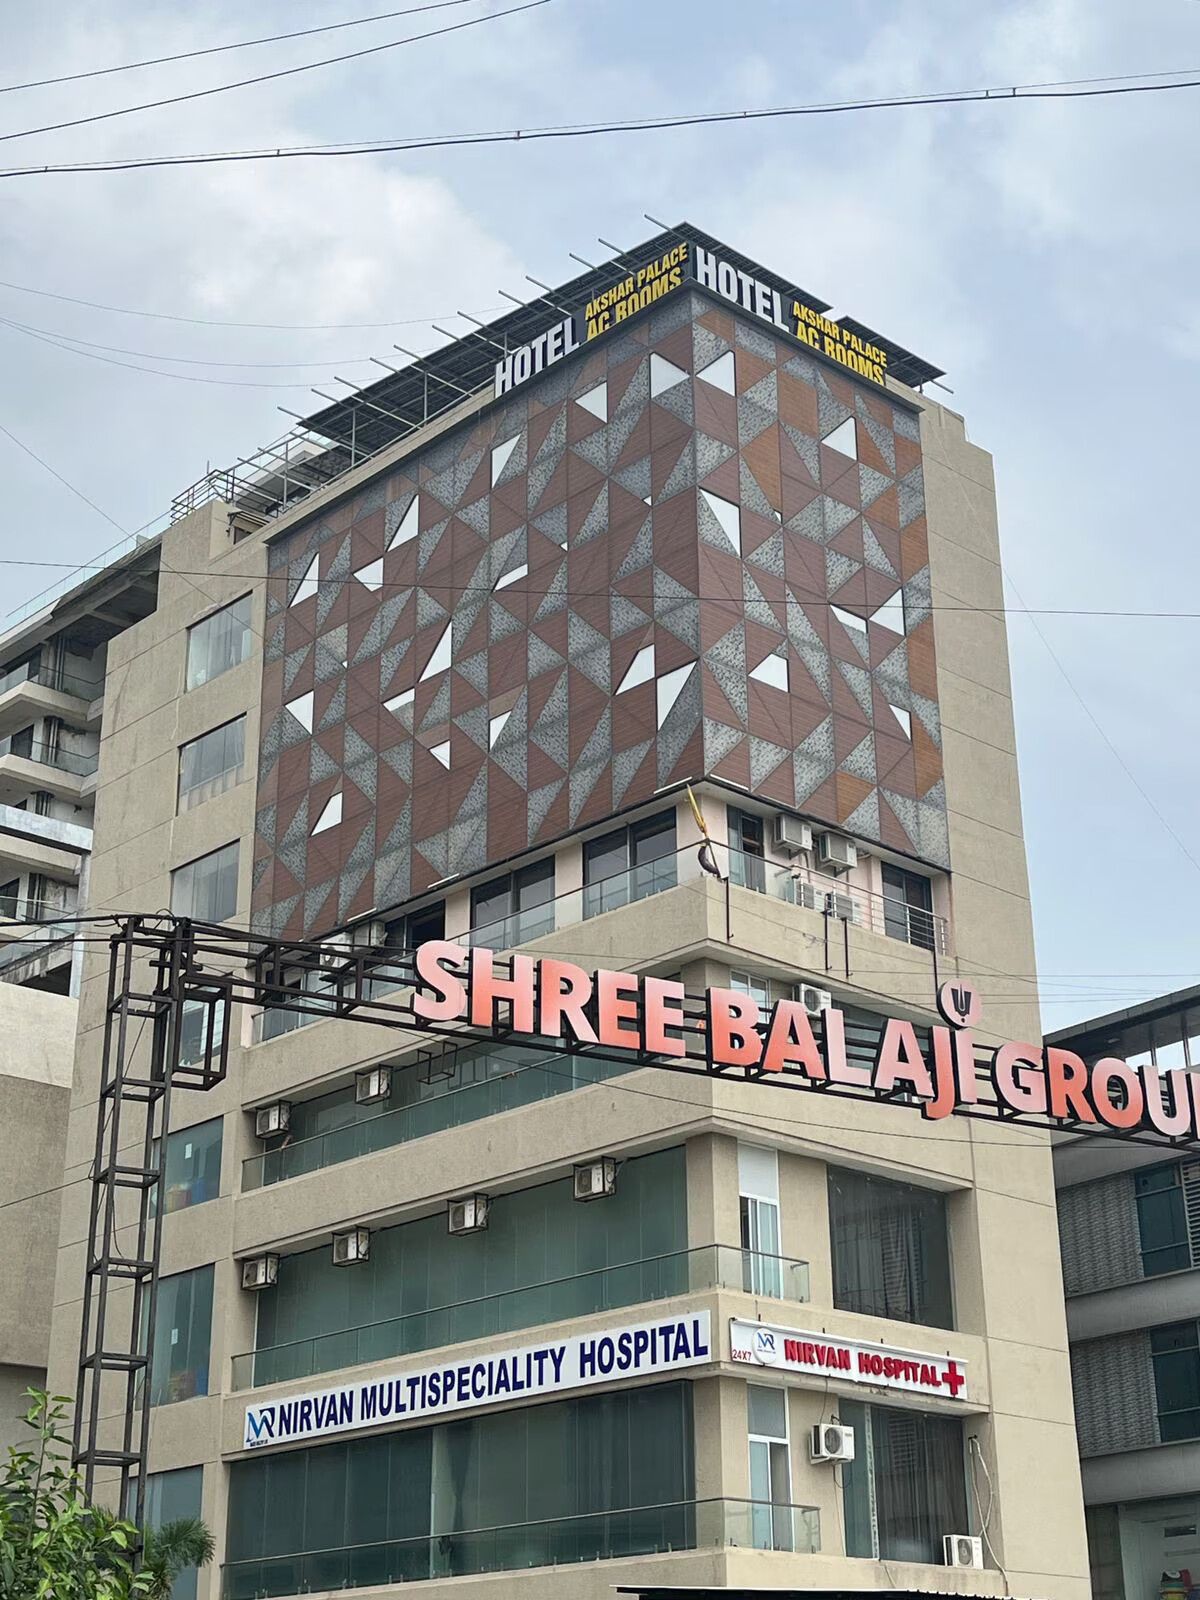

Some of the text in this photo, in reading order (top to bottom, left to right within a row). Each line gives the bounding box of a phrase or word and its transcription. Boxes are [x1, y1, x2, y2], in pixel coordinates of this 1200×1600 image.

[585, 242, 690, 322] AKSHAR PALACE
[586, 266, 683, 342] AC ROOMS
[696, 246, 790, 333] HOTEL
[495, 317, 580, 399] HOTEL
[793, 300, 888, 369] AKSHAR PALACE
[796, 319, 886, 388] AC ROOMS
[410, 938, 687, 1058] SHREE
[993, 1039, 1200, 1140] GROU
[278, 1319, 709, 1437] NIRVAN MULTISPECIALITY HOSPITAL
[784, 1339, 942, 1388] NIRVAN HOSPITAL
